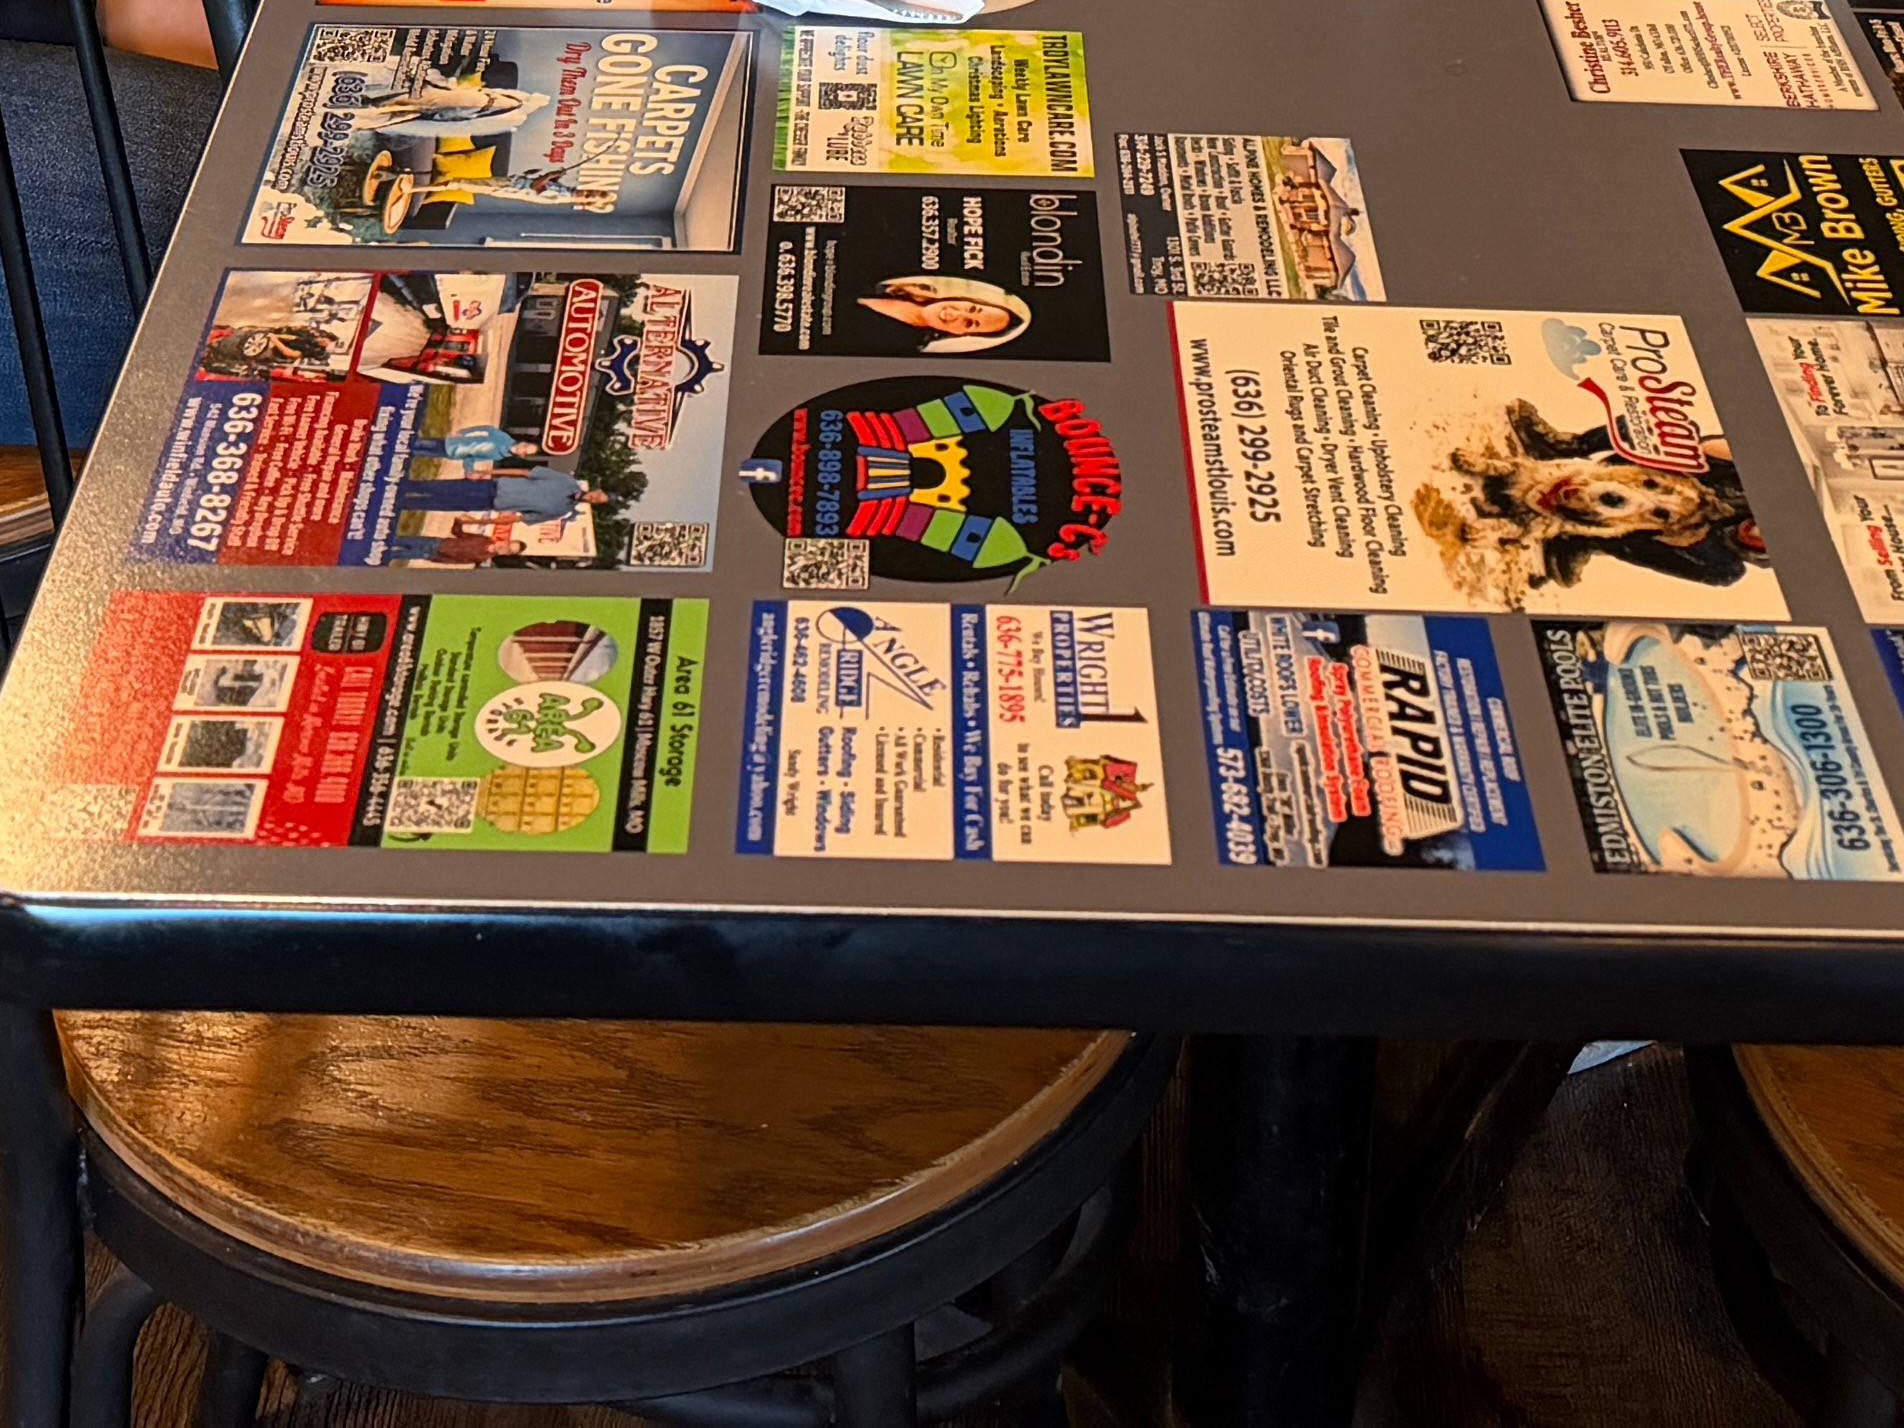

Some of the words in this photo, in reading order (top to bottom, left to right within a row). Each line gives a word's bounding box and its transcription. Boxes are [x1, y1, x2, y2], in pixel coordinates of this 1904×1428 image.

[1564, 1, 1591, 38] Besher
[1746, 13, 1769, 41] SELECT
[589, 33, 657, 110] GONE
[896, 51, 923, 98] LAWN
[1580, 41, 1611, 94] Christine
[1764, 51, 1798, 106] BERKSHIRE
[1784, 53, 1816, 108] HATHAWAY
[629, 65, 709, 175] CARPETS
[895, 104, 924, 146] CARE
[966, 105, 984, 144] Lighting
[1041, 35, 1077, 173] TROYLAWNCARE.COM
[1242, 137, 1261, 168] ALPINE
[1244, 171, 1265, 203] HOMES
[1798, 155, 1866, 240] Brown
[1859, 158, 1895, 206] GUTTERS
[921, 196, 939, 269] 636.357.2900
[963, 197, 982, 234] HOPE
[1029, 194, 1083, 286] blondin
[964, 237, 984, 269] FICK
[1254, 214, 1277, 276] REMODELING
[1264, 279, 1281, 296] LLC
[1840, 248, 1900, 315] Mike
[545, 285, 596, 448] AUTOMOTIVE
[628, 285, 682, 449] ALTERNATIVE
[1278, 350, 1301, 392] Oriental
[1324, 336, 1342, 353] and
[1328, 356, 1350, 386] Grout
[1351, 346, 1375, 379] Carpet
[1226, 369, 1264, 419] (636)
[1306, 362, 1328, 385] Duct
[1308, 388, 1334, 434] Cleaning
[1332, 389, 1360, 436] Cleaning
[1358, 384, 1386, 430] Cleaning
[1186, 338, 1241, 556] www.prosteamstlouis.com
[1290, 424, 1308, 444] and
[1318, 443, 1342, 472] Dryer
[142, 397, 204, 543] www.winfieldauto.com
[187, 393, 263, 550] 636-368-8267
[815, 410, 843, 536] 636-898-7893
[1009, 429, 1038, 524] INFLATABLES
[1235, 424, 1281, 523] 299-2925
[1289, 448, 1316, 483] Carpet
[1324, 476, 1346, 502] Vent
[1345, 445, 1372, 504] Hardwood
[1370, 439, 1397, 502] Upholstery
[1299, 486, 1328, 548] Stretching
[1330, 504, 1357, 558] Cleaning
[1355, 508, 1376, 538] Floor
[1382, 504, 1410, 556] Cleaning
[1362, 542, 1390, 594] Cleaning
[1865, 525, 1893, 567] Selling
[674, 657, 698, 694] Area
[816, 643, 832, 713] REMODELING
[837, 650, 862, 706] RIDGE
[871, 617, 946, 697] ANGLE
[996, 616, 1024, 723] 636-775-1895
[1053, 612, 1074, 727] PROPERTIES
[1547, 629, 1581, 690] POOLS
[672, 702, 696, 717] 61
[1380, 664, 1452, 805] RAPID
[1568, 695, 1598, 749] ELITE
[658, 724, 693, 787] Storage
[815, 726, 835, 776] Gutters
[837, 727, 857, 777] Roofing
[1790, 704, 1871, 851] 636-306-1300
[814, 790, 832, 852] Windows
[834, 791, 856, 833] Siding
[964, 786, 983, 809] For
[1216, 748, 1256, 864] 573-682-4039
[1583, 753, 1631, 863] EDMISTON
[965, 814, 985, 850] Cash
